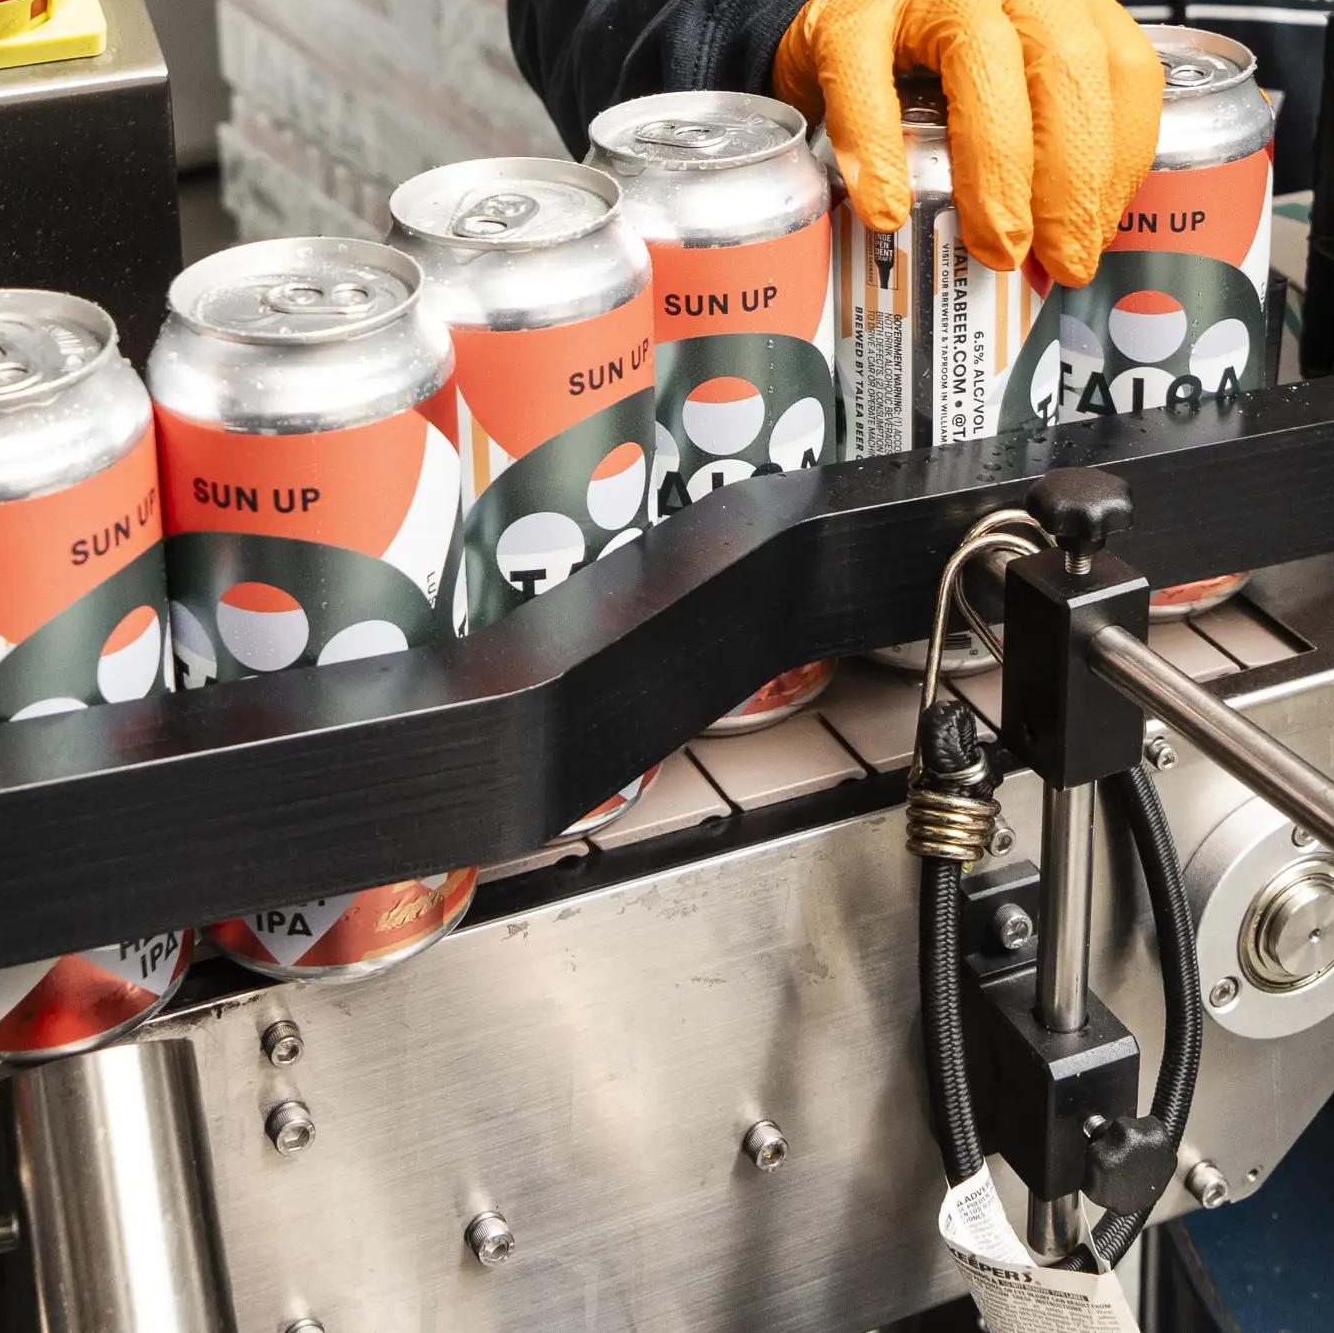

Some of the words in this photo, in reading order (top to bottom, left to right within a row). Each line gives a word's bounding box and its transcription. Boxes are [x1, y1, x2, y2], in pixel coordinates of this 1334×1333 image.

[1117, 212, 1158, 233] UN
[1169, 210, 1206, 233] UP
[664, 293, 729, 317] SUN
[741, 285, 778, 313] UP
[867, 310, 875, 321] TO
[855, 307, 863, 357] BREWED
[867, 322, 875, 347] DRIVE
[952, 245, 968, 394] TALEABEER.COM
[893, 315, 901, 372] GOVERNMENT
[973, 331, 984, 364] 6.5%
[568, 356, 624, 396] SUN
[631, 337, 650, 372] UP
[855, 361, 863, 377] BY
[867, 356, 875, 373] CAR
[867, 375, 875, 388] OR
[875, 377, 884, 389] (2)
[893, 373, 901, 414] WARNING:
[941, 392, 948, 401] IN
[855, 381, 863, 417] TALEA
[867, 390, 875, 425] OPERATE
[973, 369, 984, 434] ALC/VOL
[855, 422, 863, 450] BEER
[893, 417, 902, 426] (1)
[193, 477, 259, 514] SUN
[274, 486, 321, 515] UP
[71, 515, 131, 566] SUN
[139, 487, 160, 530] UP
[256, 910, 313, 937] IPA
[140, 931, 180, 980] IPA
